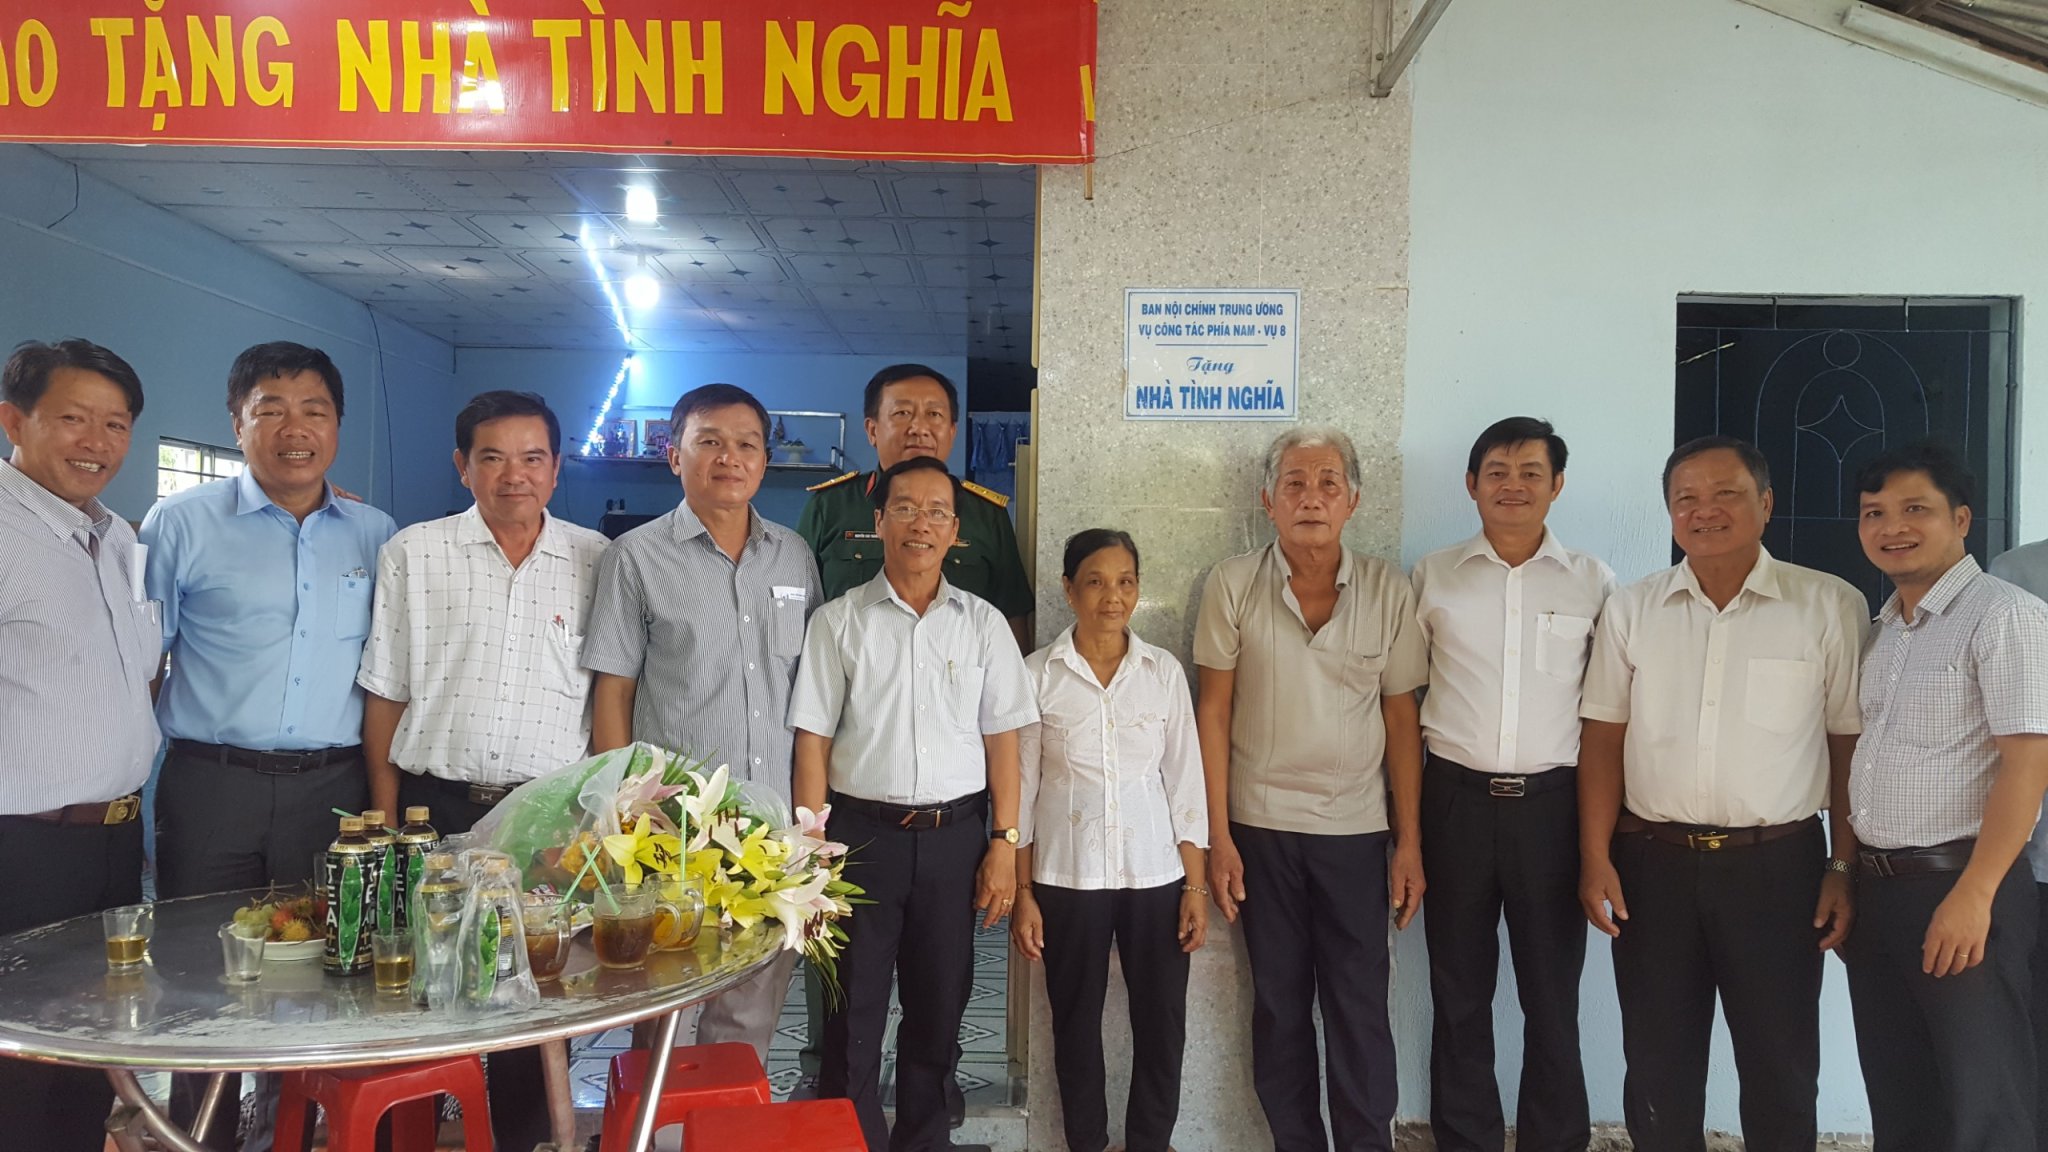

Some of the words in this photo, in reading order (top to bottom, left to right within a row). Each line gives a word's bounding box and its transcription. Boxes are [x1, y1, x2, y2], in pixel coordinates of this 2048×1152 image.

[0, 19, 58, 107] O
[336, 0, 504, 114] NHÀ
[532, 0, 724, 114] TÌNH
[763, 1, 1013, 122] NGHĨA
[1141, 303, 1162, 316] BAN
[1165, 300, 1182, 319] NỘI
[1185, 300, 1216, 316] CHÍNH
[1219, 303, 1253, 316] TRUNG
[1255, 301, 1284, 316] ƯƠNG
[1138, 324, 1152, 340] VỤ
[1154, 321, 1182, 337] CÔNG
[1185, 321, 1205, 337] TÁC
[1207, 321, 1231, 337] PHÍA
[1233, 324, 1256, 337] NAM
[1263, 324, 1278, 340] VỤ
[1279, 324, 1287, 337] 8
[1186, 356, 1235, 375] Tặng
[1136, 378, 1174, 410] NHÀ
[1179, 379, 1222, 410] TÌNH
[1227, 379, 1285, 410] NGHĨA
